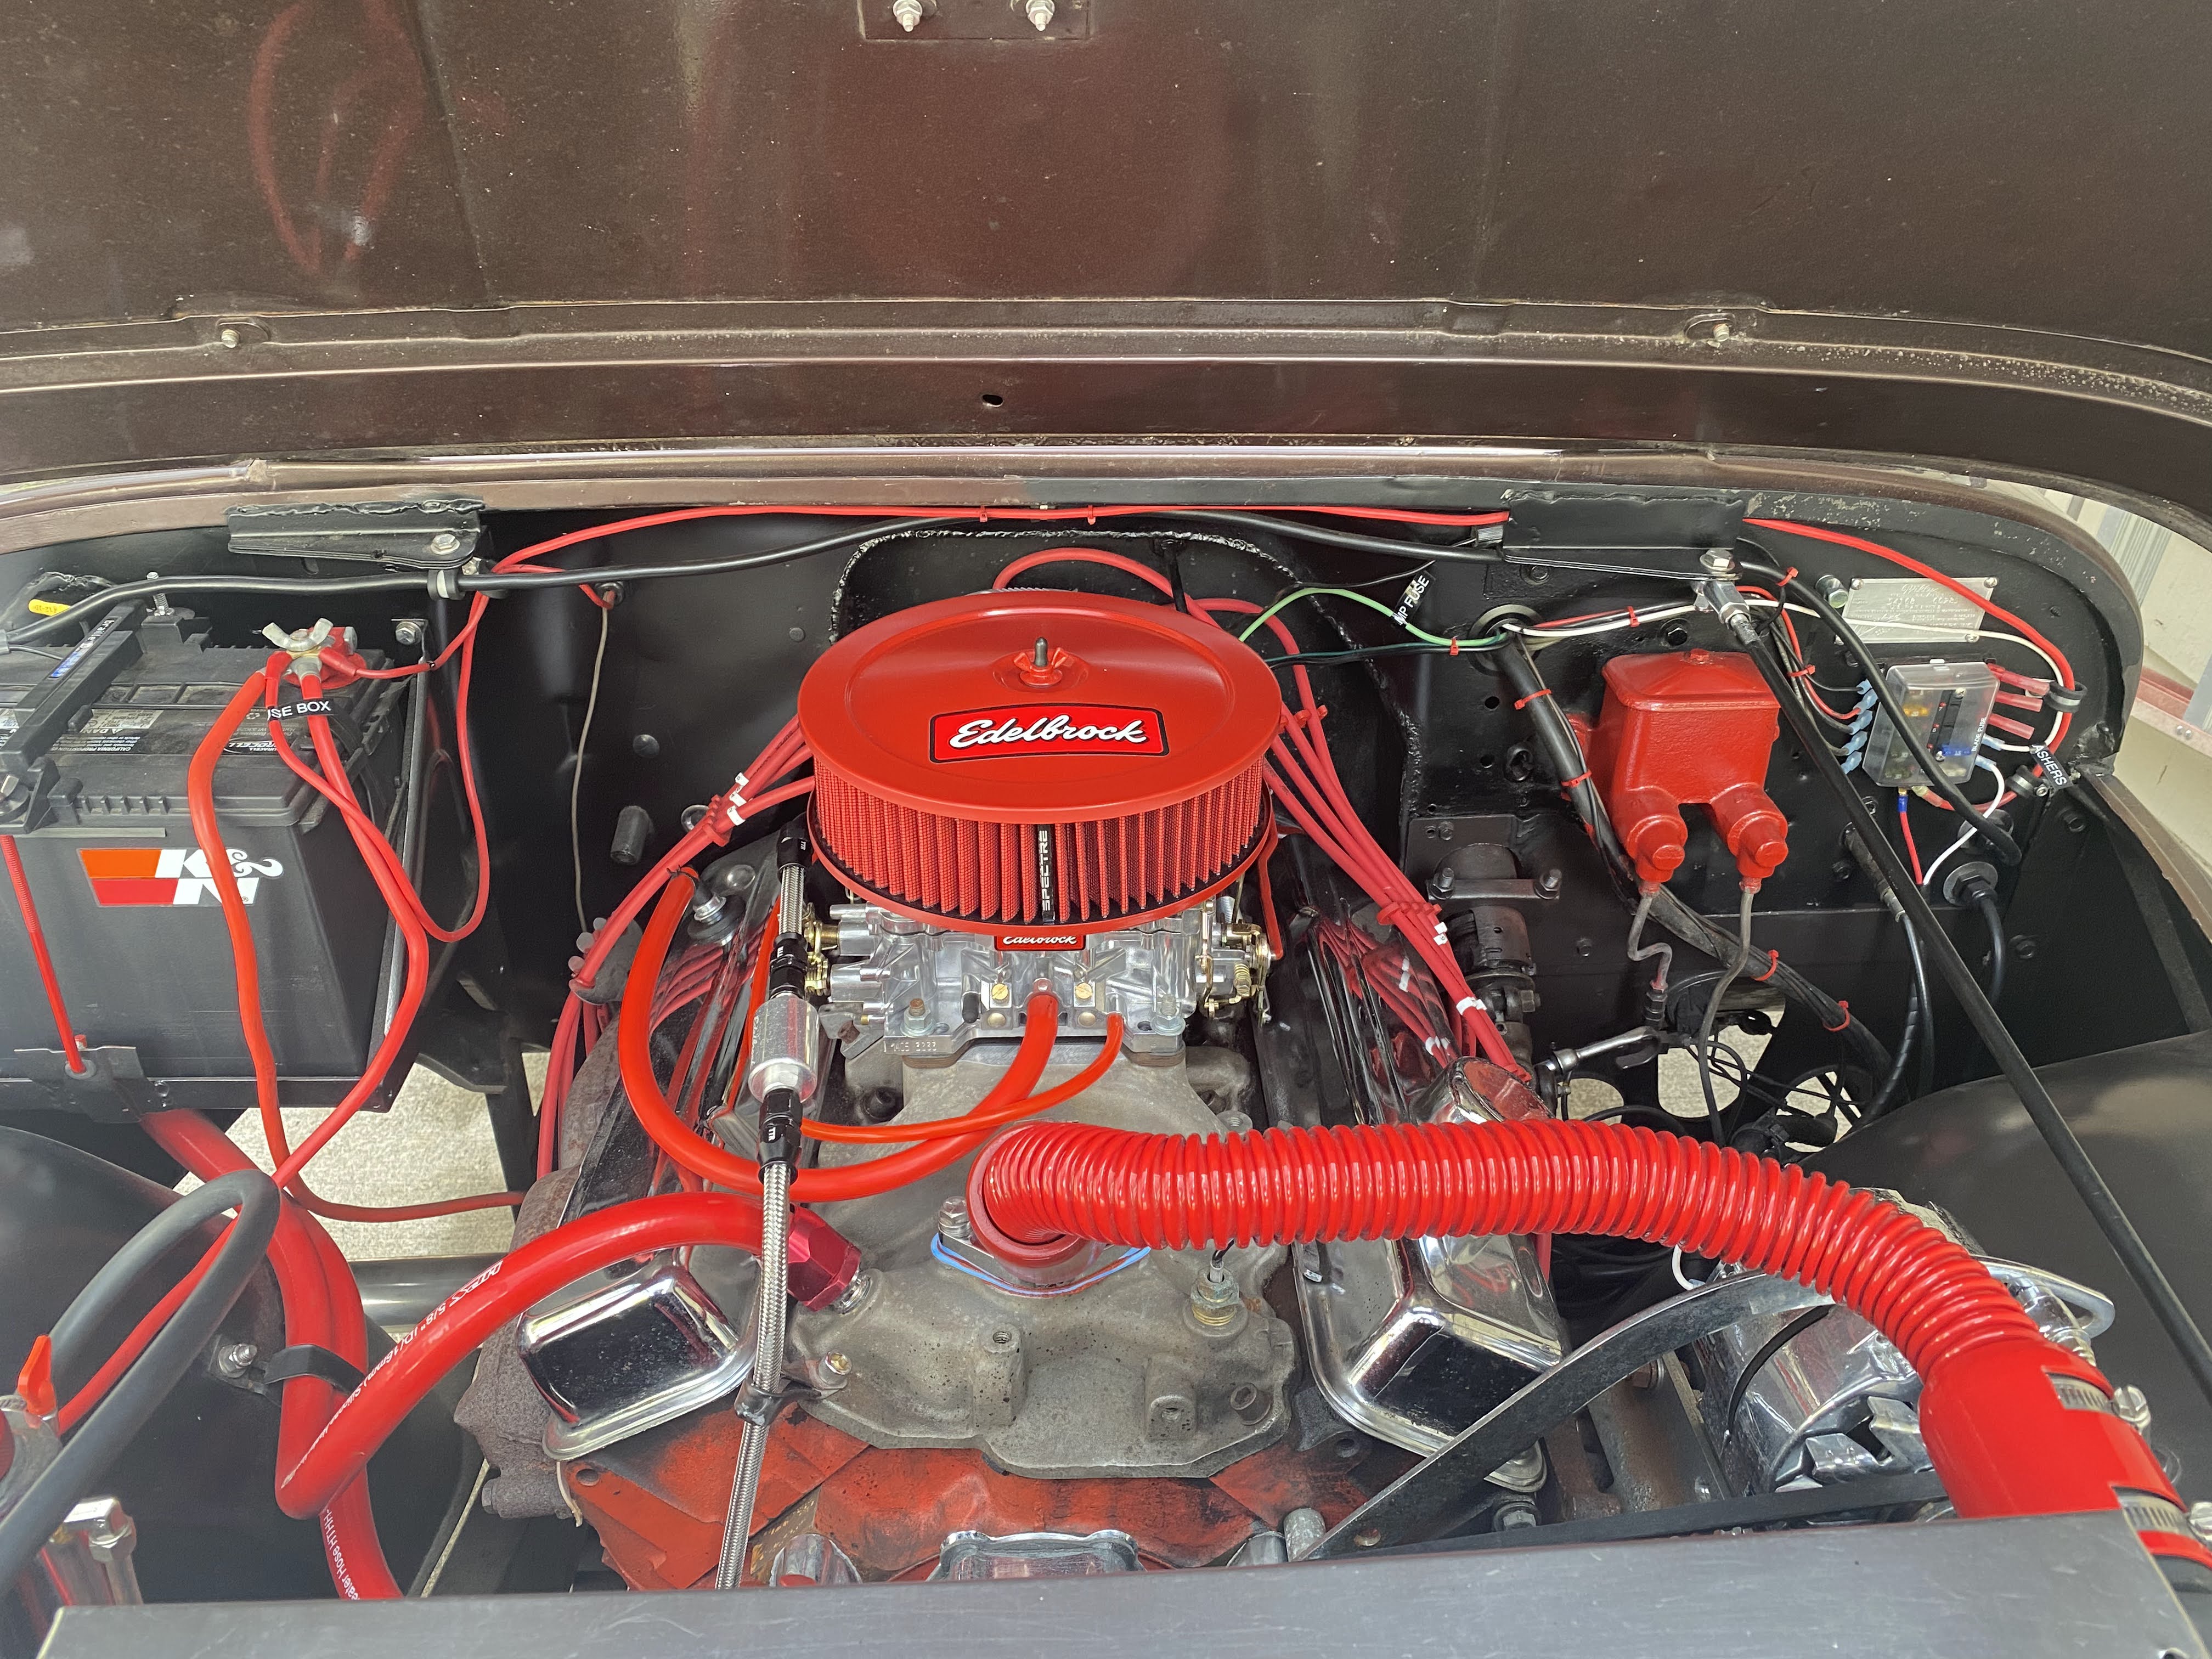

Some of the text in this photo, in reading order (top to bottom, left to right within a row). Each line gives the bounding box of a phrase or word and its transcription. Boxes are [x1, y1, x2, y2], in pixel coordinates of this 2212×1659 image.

[1404, 575, 1430, 608] FUSE
[296, 701, 331, 714] BOX
[949, 715, 1149, 749] Edelbrock
[1971, 717, 1987, 752] BLADE FUSE
[2032, 744, 2067, 786] ASHERS
[1039, 830, 1051, 911] SPECTRE
[421, 1301, 447, 1330] 5/8"
[332, 1546, 347, 1579] Hose
[340, 1573, 360, 1600] eater
